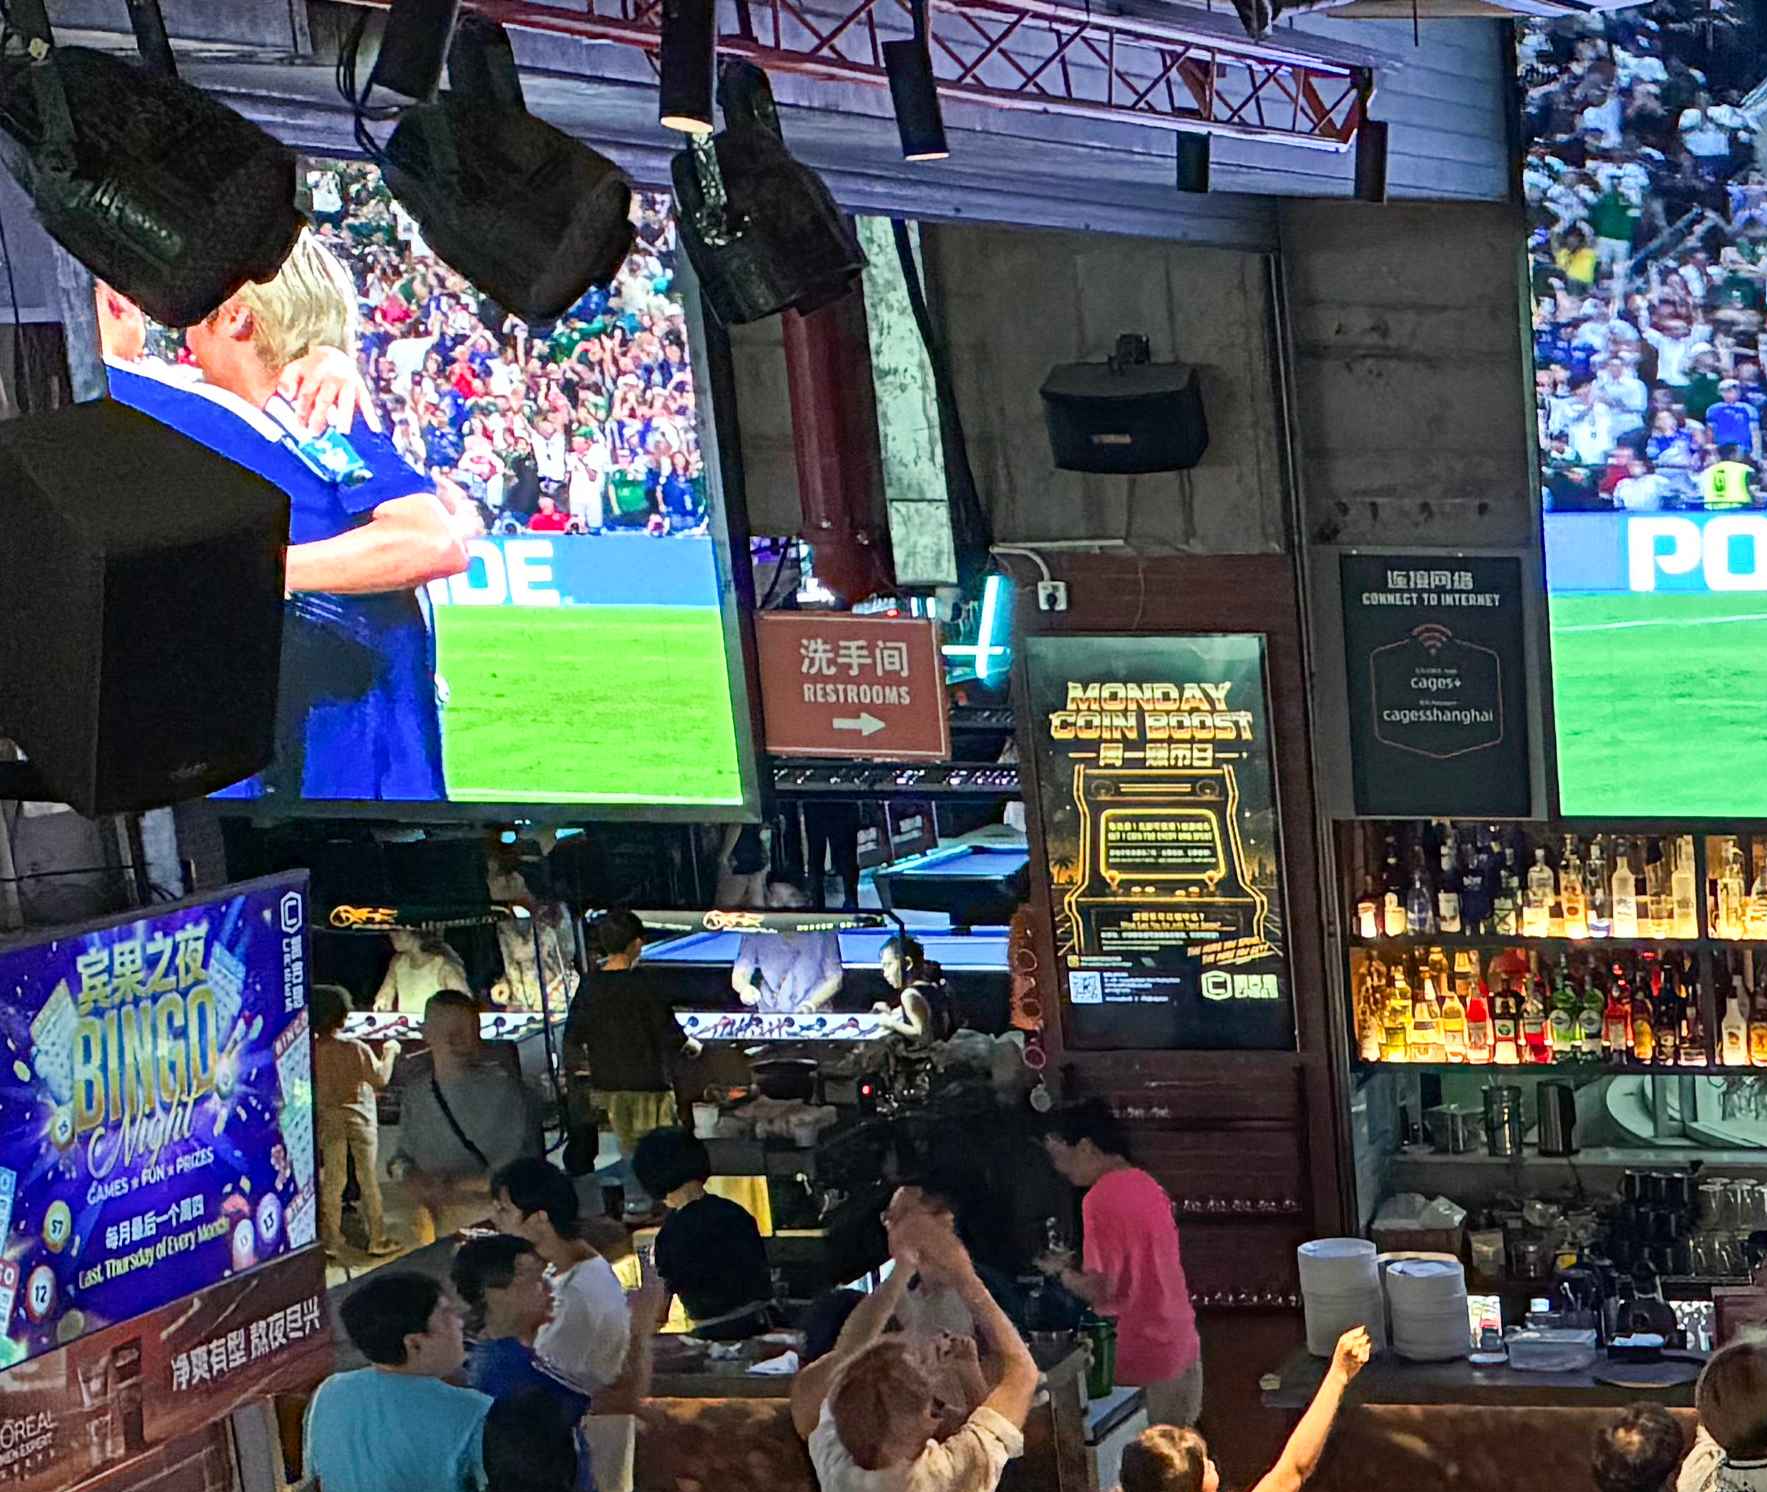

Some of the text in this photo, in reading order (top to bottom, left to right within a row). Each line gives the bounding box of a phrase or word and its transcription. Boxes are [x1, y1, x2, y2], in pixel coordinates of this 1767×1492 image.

[1362, 592, 1500, 606] CONNECT TO INTERNET
[801, 638, 909, 677] 洗手间
[803, 683, 911, 705] RESTROOMS
[1067, 681, 1232, 711] MONDAY
[1049, 711, 1254, 741] COIN BOOST
[1383, 708, 1494, 724] cagesshanghai
[76, 917, 209, 1014] 宾果之夜
[72, 985, 218, 1134] BINGO
[88, 1080, 213, 1180] Night
[87, 1146, 214, 1206] GAMES FUN PRIZES
[50, 1217, 65, 1235] 57
[78, 1266, 104, 1290] Last
[106, 1245, 156, 1284] Thursday
[156, 1236, 168, 1261] of
[166, 1226, 197, 1257] Every
[34, 1285, 48, 1304] 12
[171, 1328, 248, 1393] 净爽有型
